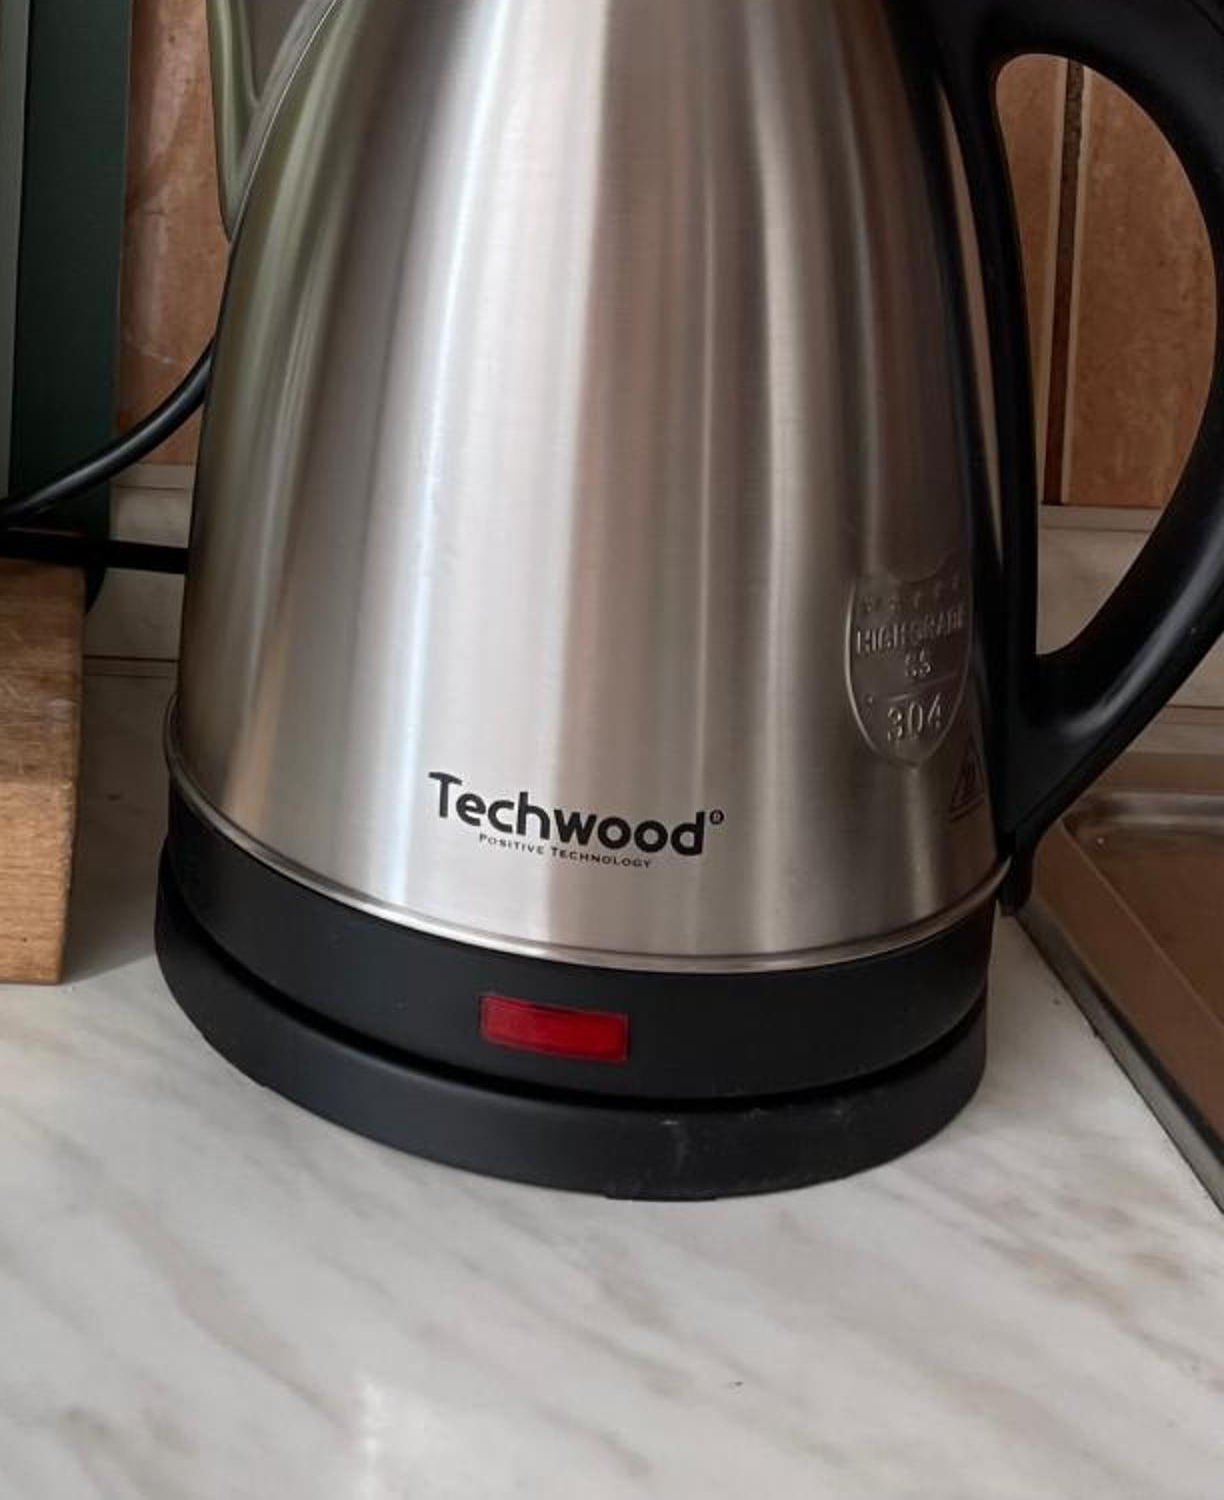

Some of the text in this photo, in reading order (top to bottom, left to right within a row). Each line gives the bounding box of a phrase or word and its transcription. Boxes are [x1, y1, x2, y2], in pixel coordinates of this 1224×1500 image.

[887, 692, 943, 742] 304
[479, 832, 652, 869] POSITIVE TECHNOLOGY
